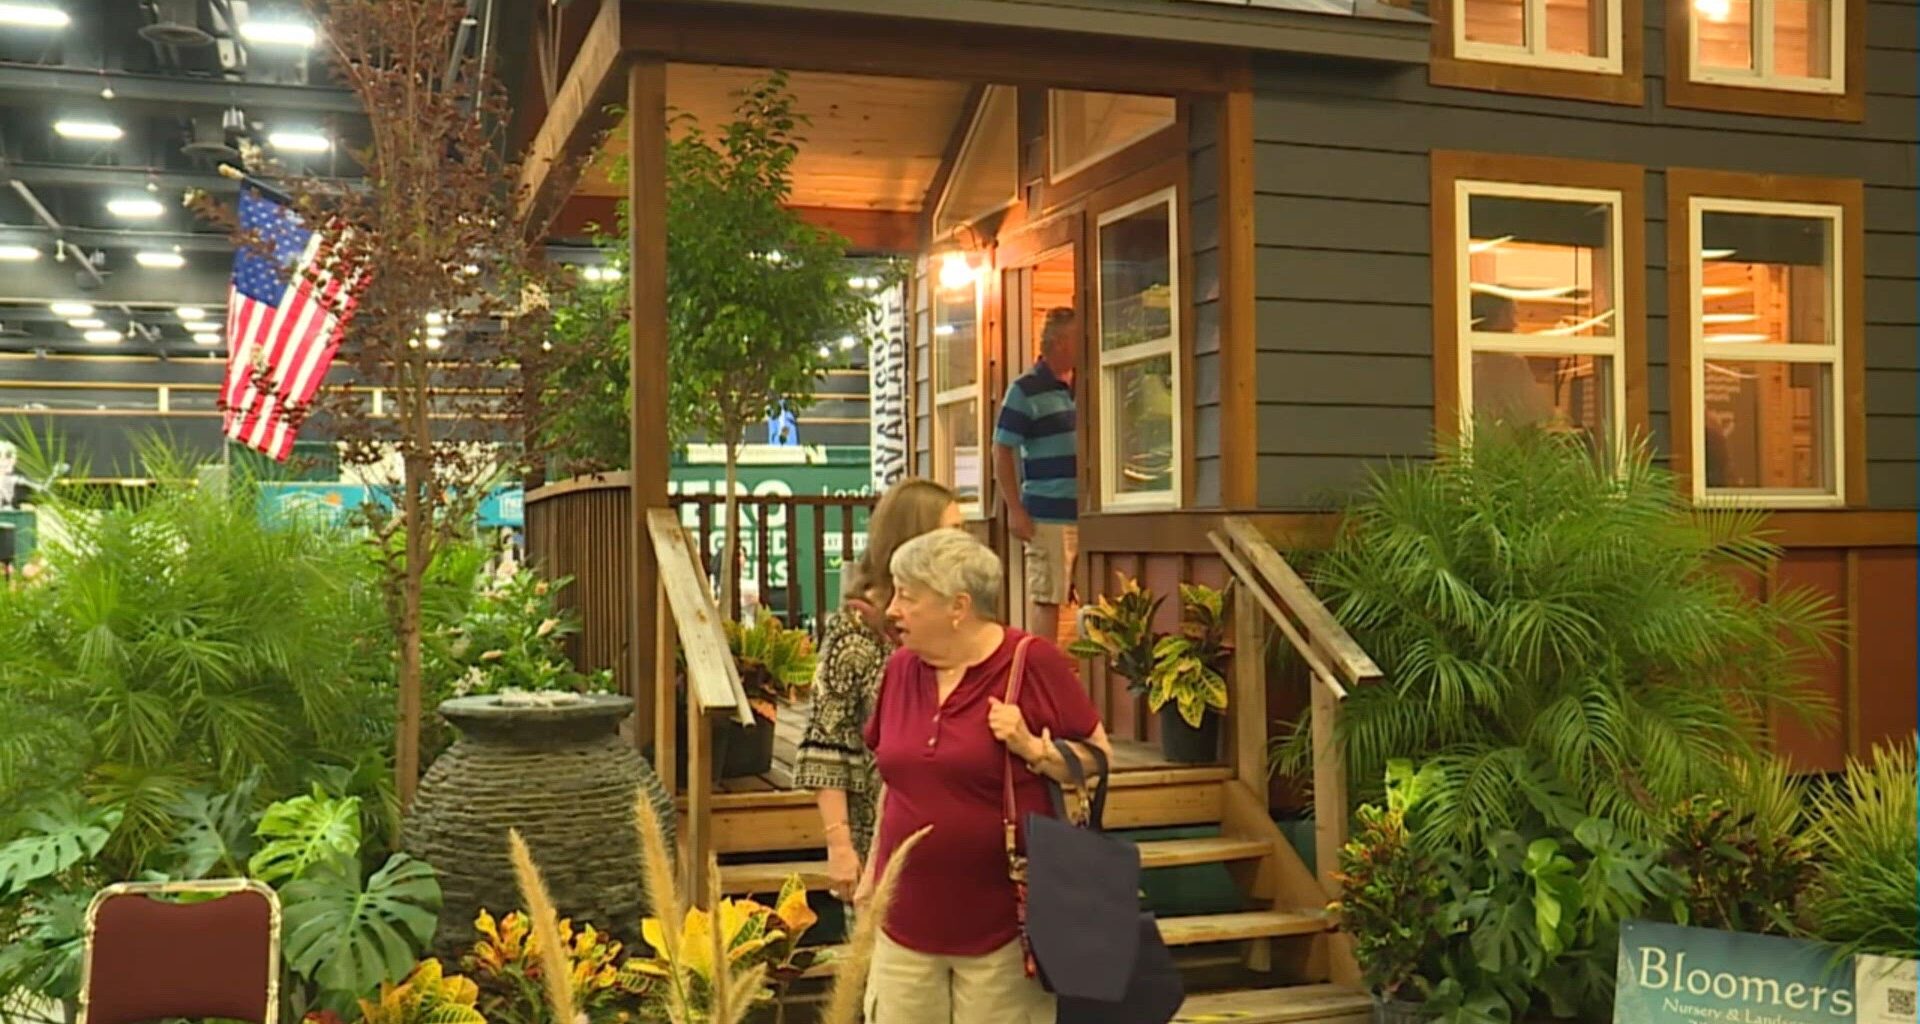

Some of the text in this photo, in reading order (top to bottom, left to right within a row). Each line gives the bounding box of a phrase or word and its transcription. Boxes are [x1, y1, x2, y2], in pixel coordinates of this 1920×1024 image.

[1637, 946, 1854, 1016] Bloomers
[1662, 997, 1722, 1020] Nursery
[1726, 1008, 1740, 1023] &
